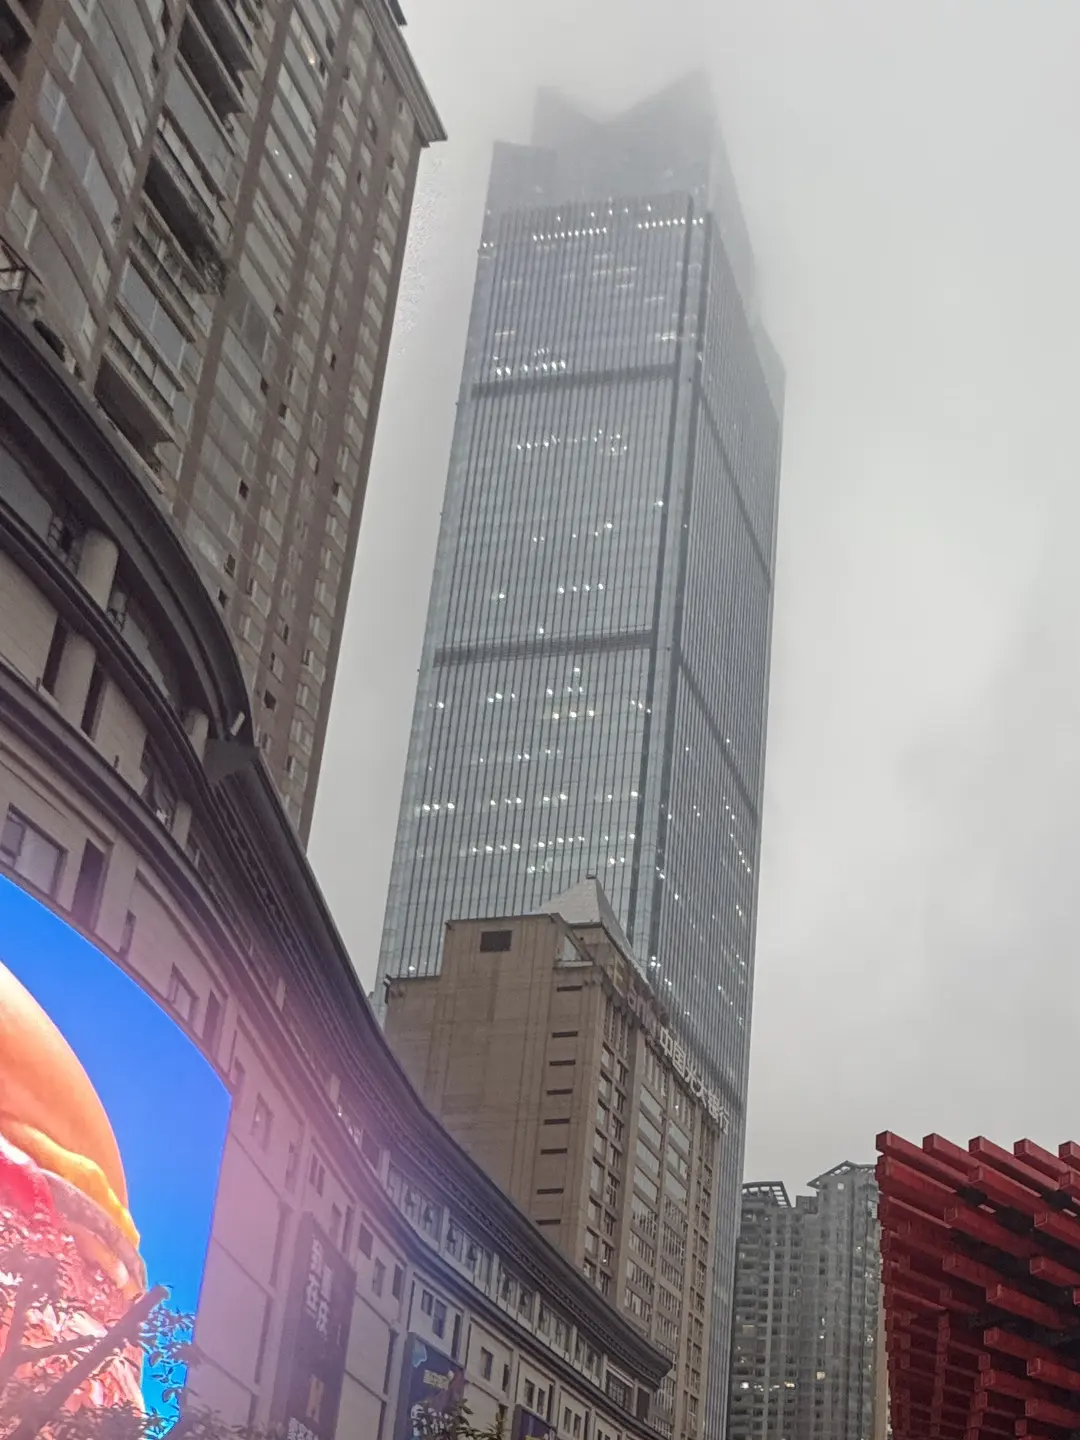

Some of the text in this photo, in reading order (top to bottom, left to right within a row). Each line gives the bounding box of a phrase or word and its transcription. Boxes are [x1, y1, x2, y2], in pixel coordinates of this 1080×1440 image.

[660, 1025, 729, 1136] 中国光大银行
